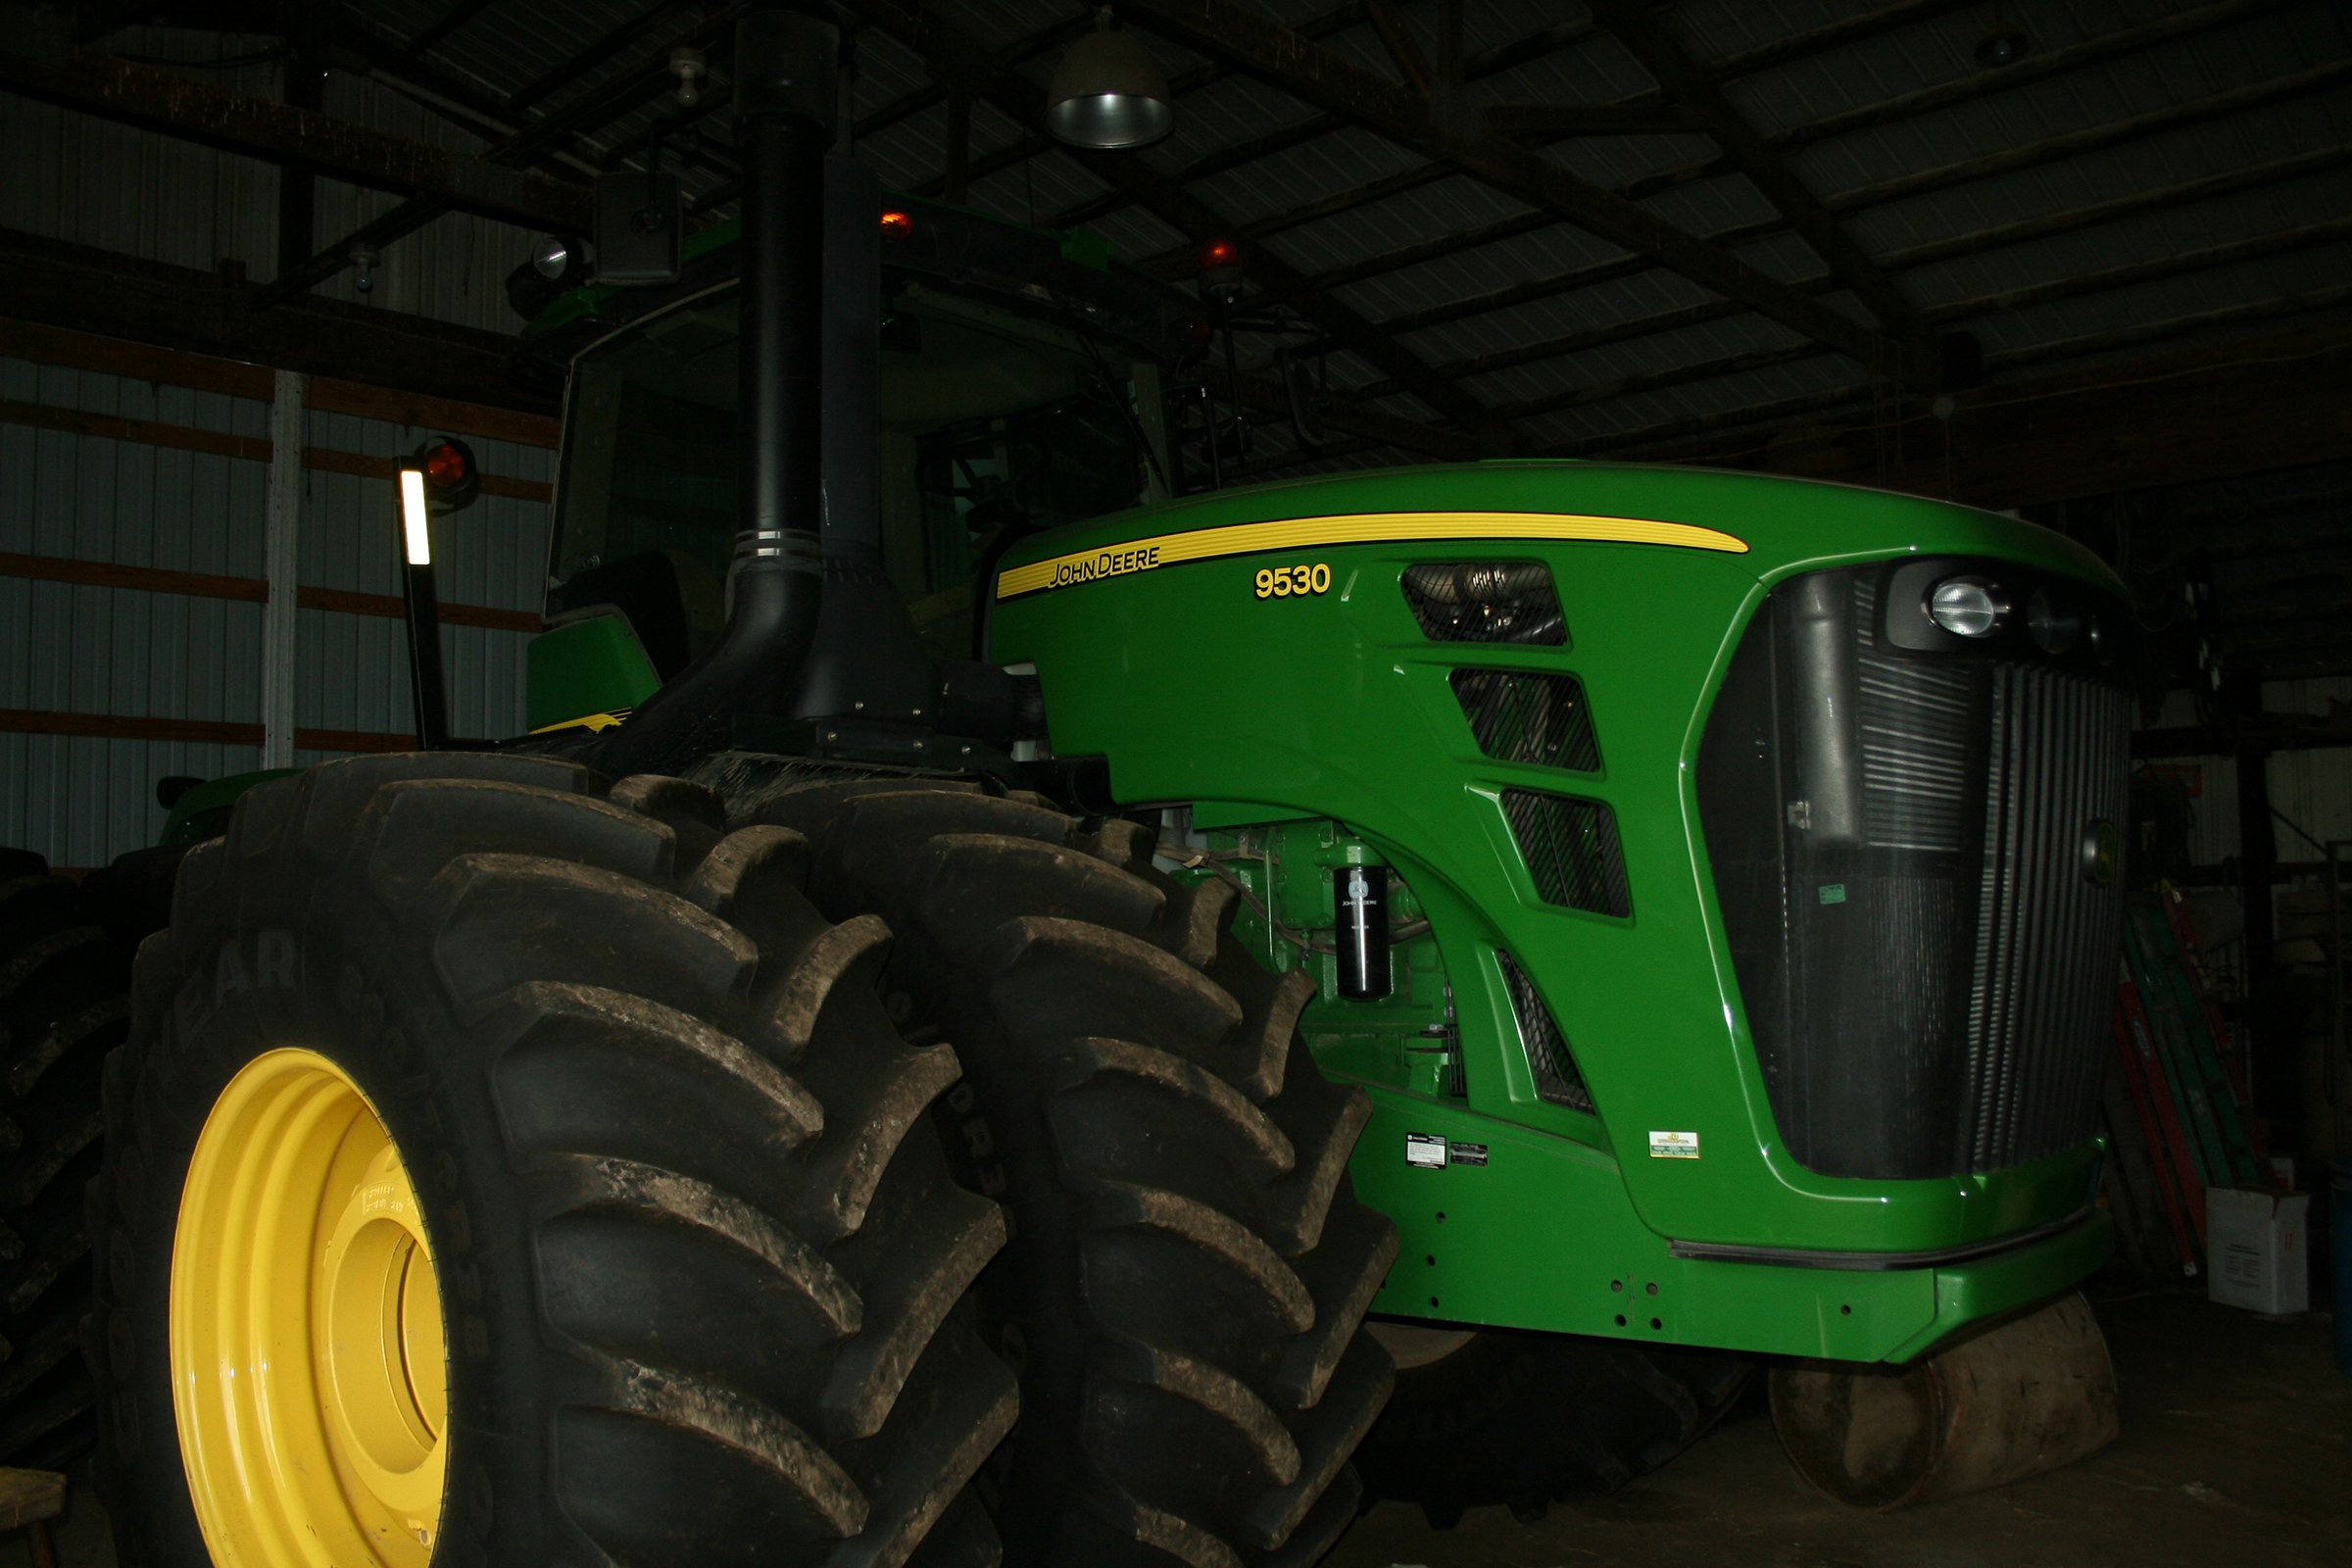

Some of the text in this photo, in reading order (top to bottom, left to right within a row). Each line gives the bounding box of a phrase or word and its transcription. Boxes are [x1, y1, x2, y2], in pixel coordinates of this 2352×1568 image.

[1049, 546, 1160, 586] JOHN DEERE
[1254, 562, 1331, 600] 9530
